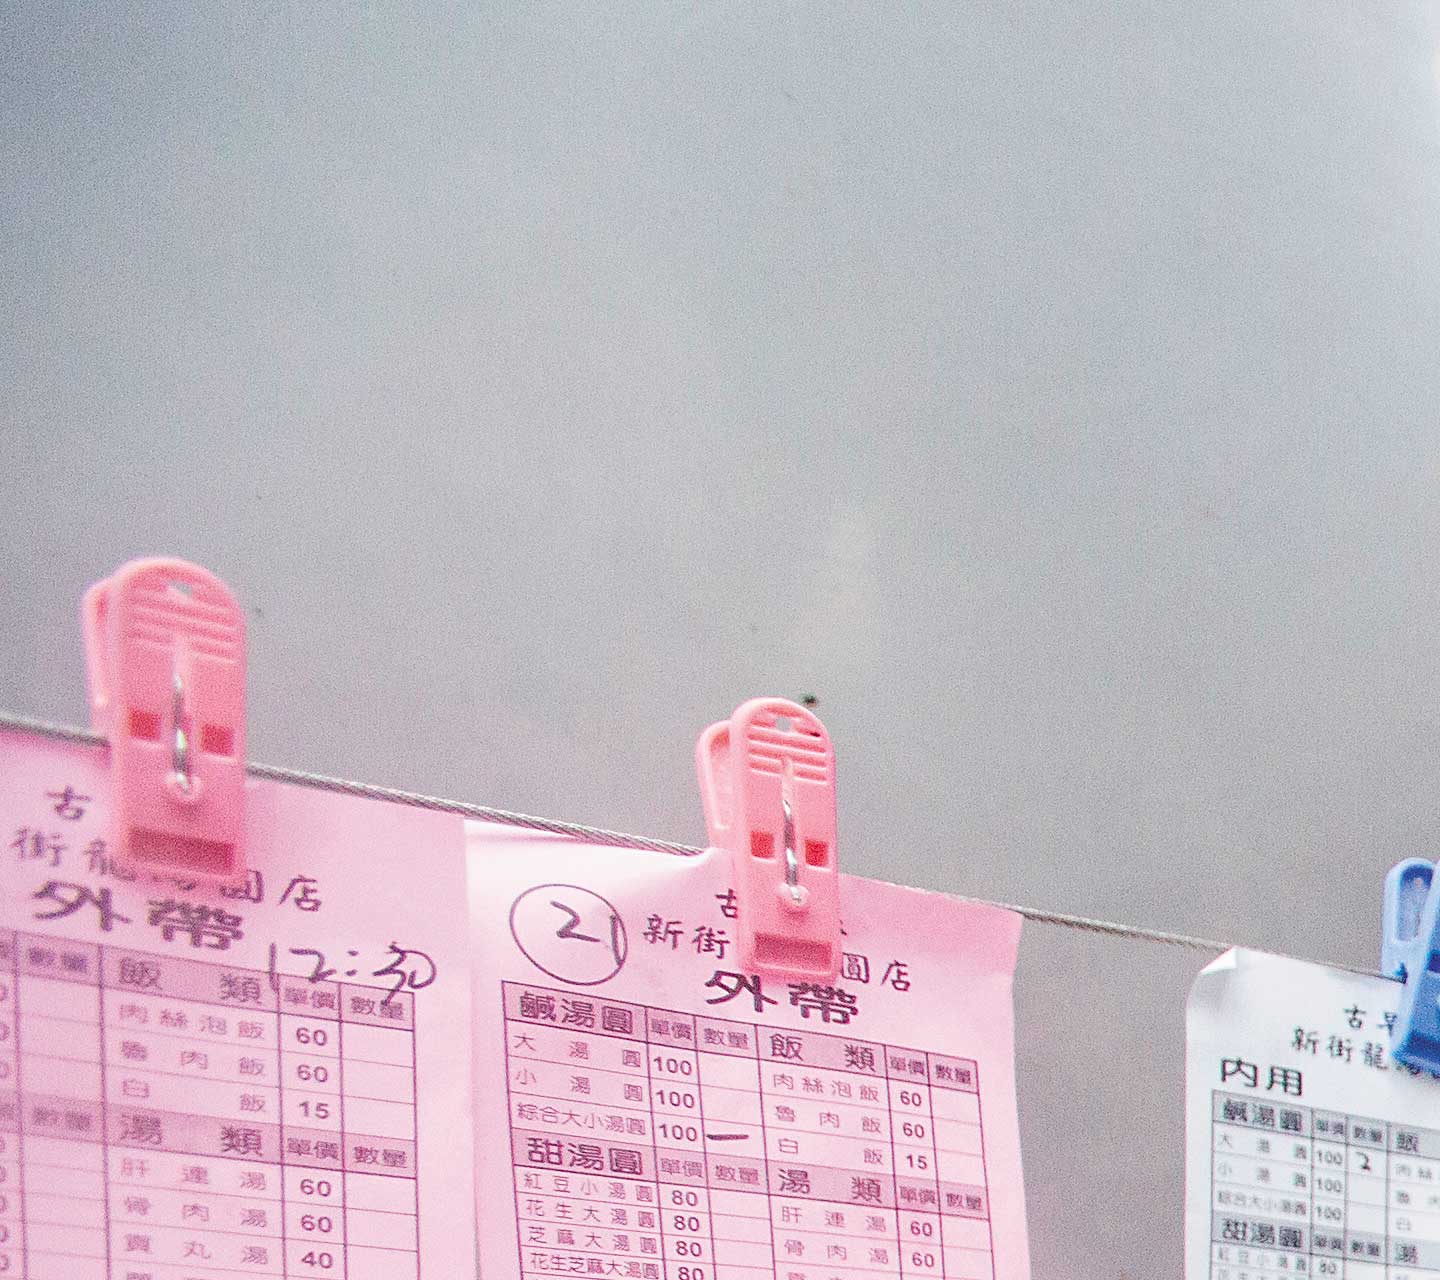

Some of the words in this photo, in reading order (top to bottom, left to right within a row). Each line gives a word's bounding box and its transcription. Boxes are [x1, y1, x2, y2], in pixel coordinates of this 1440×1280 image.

[32, 880, 245, 950] 外帶
[705, 970, 858, 1024] 外帶
[519, 991, 633, 1035] 鹹湯圓
[296, 1027, 328, 1047] 60
[770, 1033, 875, 1072] 飯類
[653, 1057, 692, 1076] 100
[656, 1089, 695, 1109] 100
[900, 1091, 922, 1107] 60
[299, 1100, 330, 1120] 15
[659, 1123, 697, 1141] 100
[903, 1122, 925, 1139] 60
[527, 1138, 643, 1175] 甜湯圓
[906, 1155, 927, 1170] 15
[1317, 1149, 1342, 1166] 100
[300, 1178, 332, 1198] 60
[672, 1190, 698, 1206] 80
[301, 1214, 333, 1233] 60
[674, 1215, 700, 1232] 80
[910, 1221, 933, 1237] 60
[675, 1240, 702, 1257] 80
[912, 1251, 935, 1268] 60
